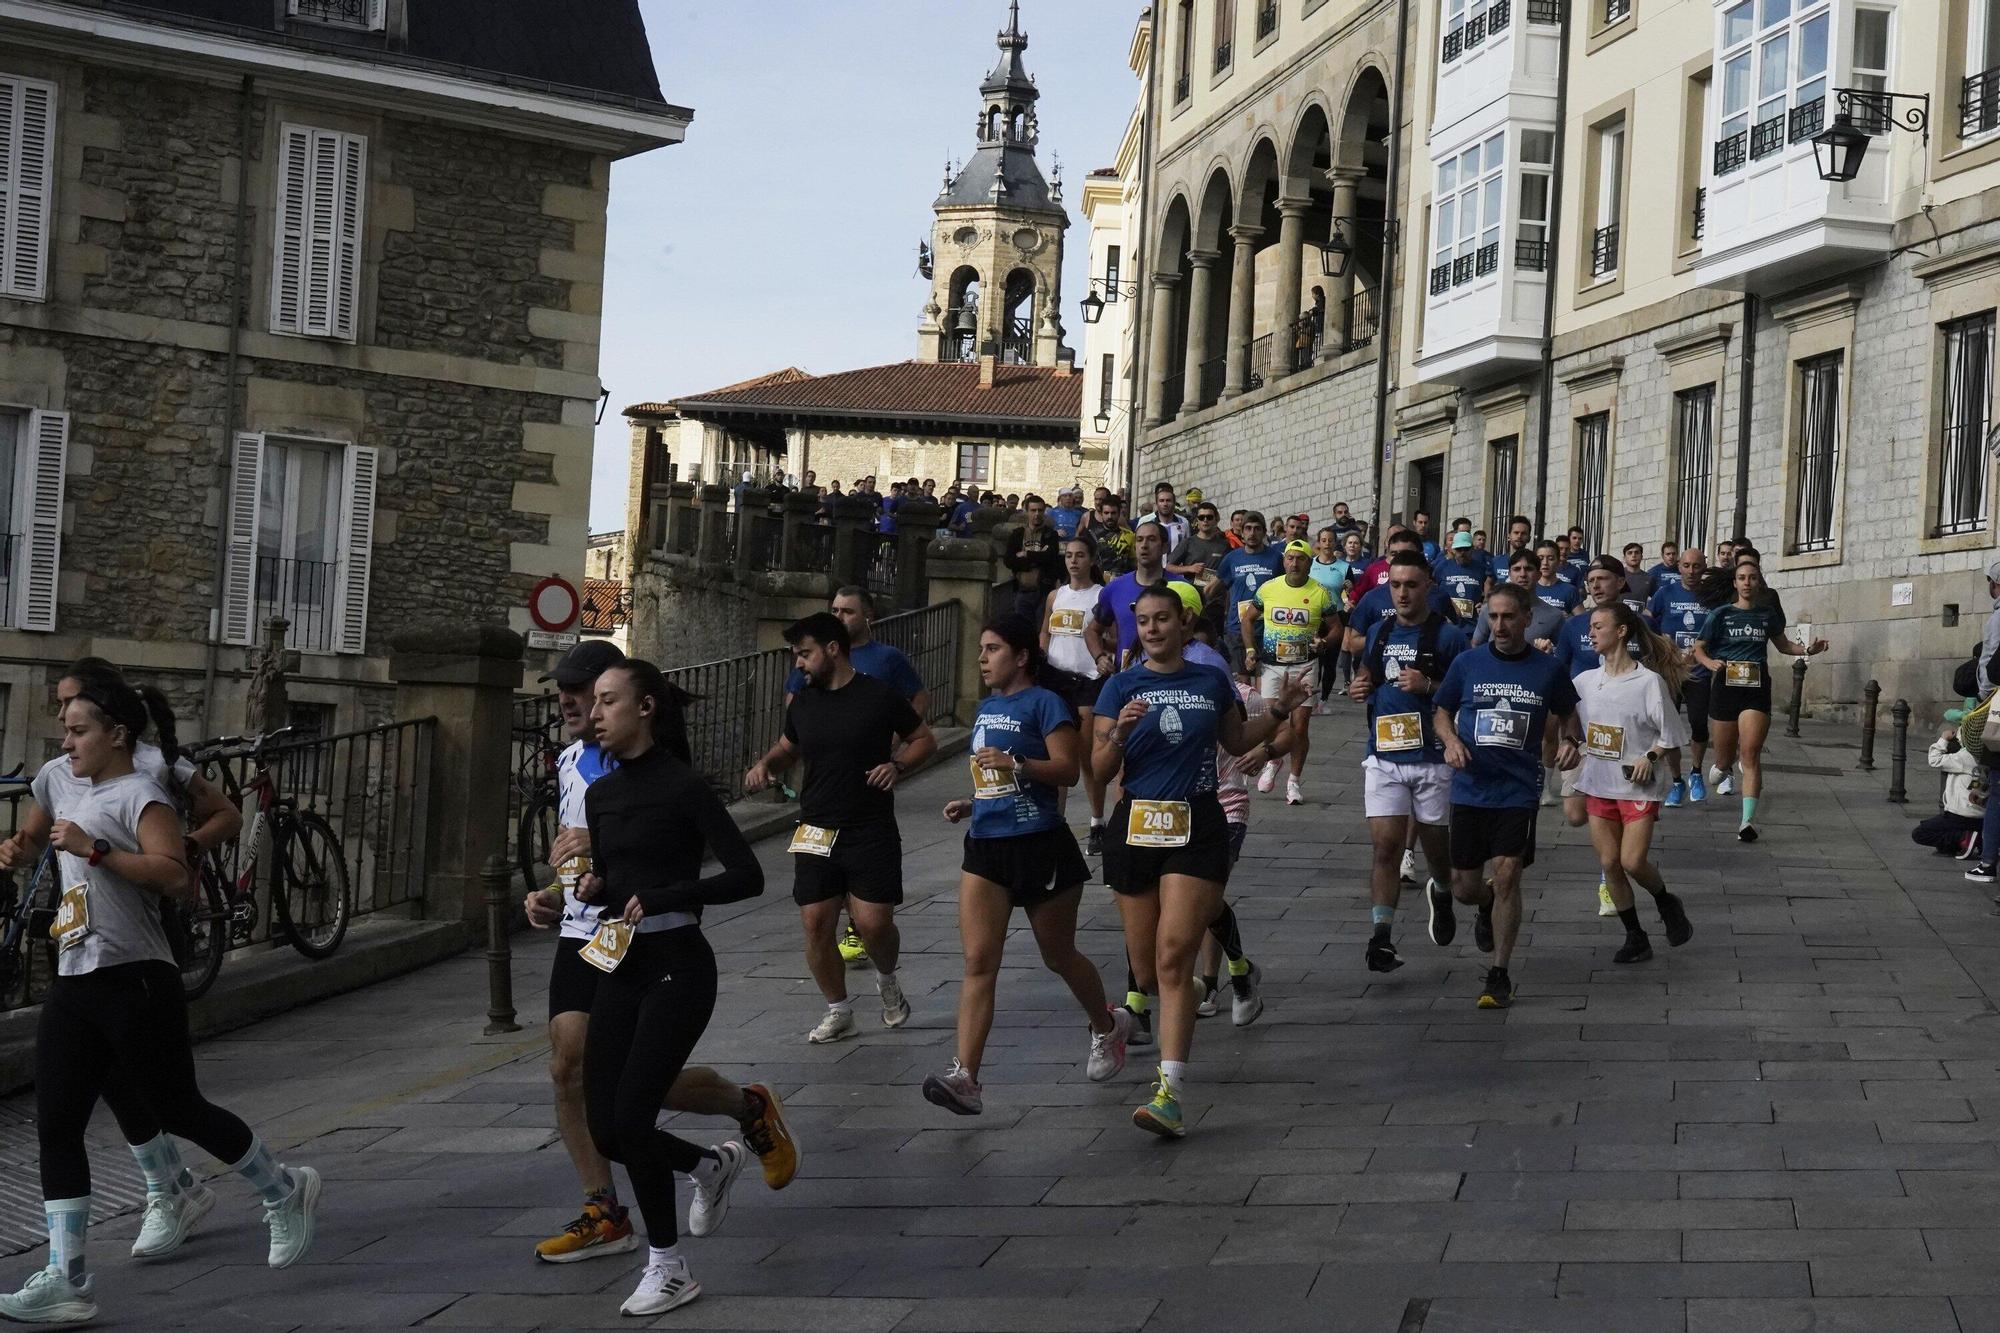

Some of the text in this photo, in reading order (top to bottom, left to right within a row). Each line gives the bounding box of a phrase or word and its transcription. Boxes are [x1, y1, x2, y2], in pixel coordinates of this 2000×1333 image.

[1062, 615, 1073, 626] 61
[1285, 646, 1301, 655] 224
[1738, 667, 1750, 678] 38
[1142, 689, 1189, 699] CONQUISTA
[1483, 689, 1536, 699] ALMENDRA
[1145, 695, 1206, 705] ALMENDRA
[1510, 696, 1543, 706] KONKISTA
[1178, 703, 1216, 711] KONKISTA
[1391, 723, 1405, 737] 92
[1490, 718, 1514, 734] 754
[1593, 731, 1612, 747] 206
[1143, 812, 1174, 830] 249
[802, 825, 825, 841] 275
